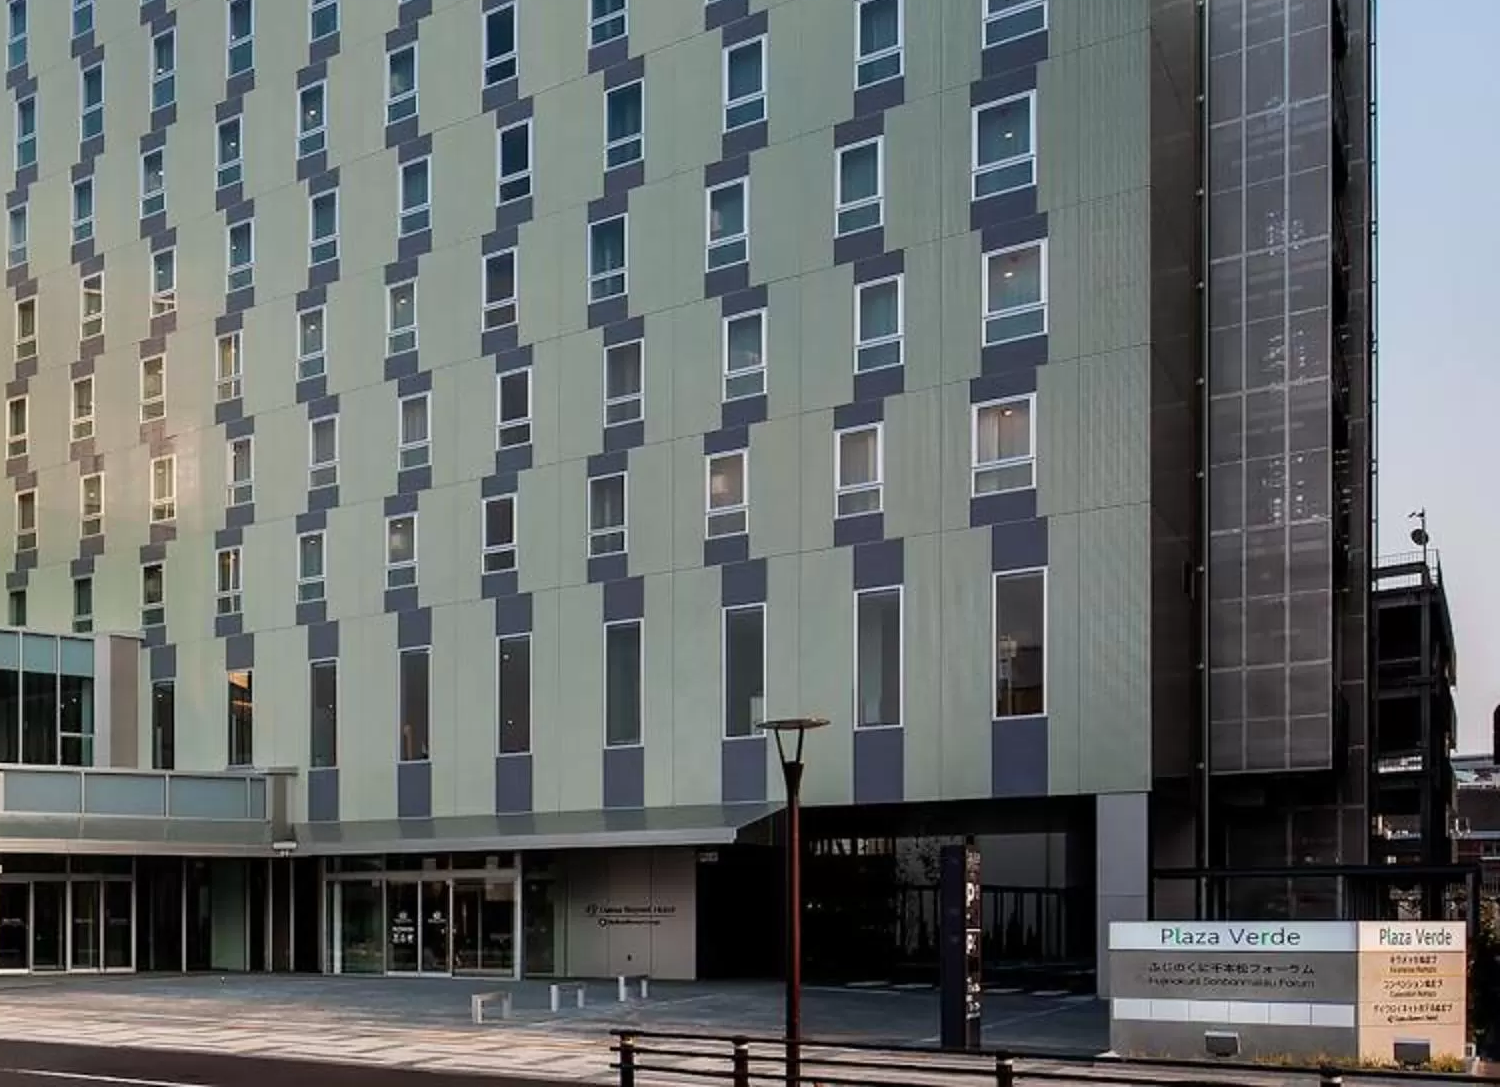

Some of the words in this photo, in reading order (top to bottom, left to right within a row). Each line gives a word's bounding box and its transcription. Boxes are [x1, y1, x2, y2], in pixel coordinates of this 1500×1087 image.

[1160, 927, 1220, 945] Plaza
[1229, 927, 1301, 945] Verde
[1379, 926, 1412, 945] Plaza
[1415, 926, 1453, 945] Verde
[1149, 962, 1315, 974] ふじのくに千本松フォーラム
